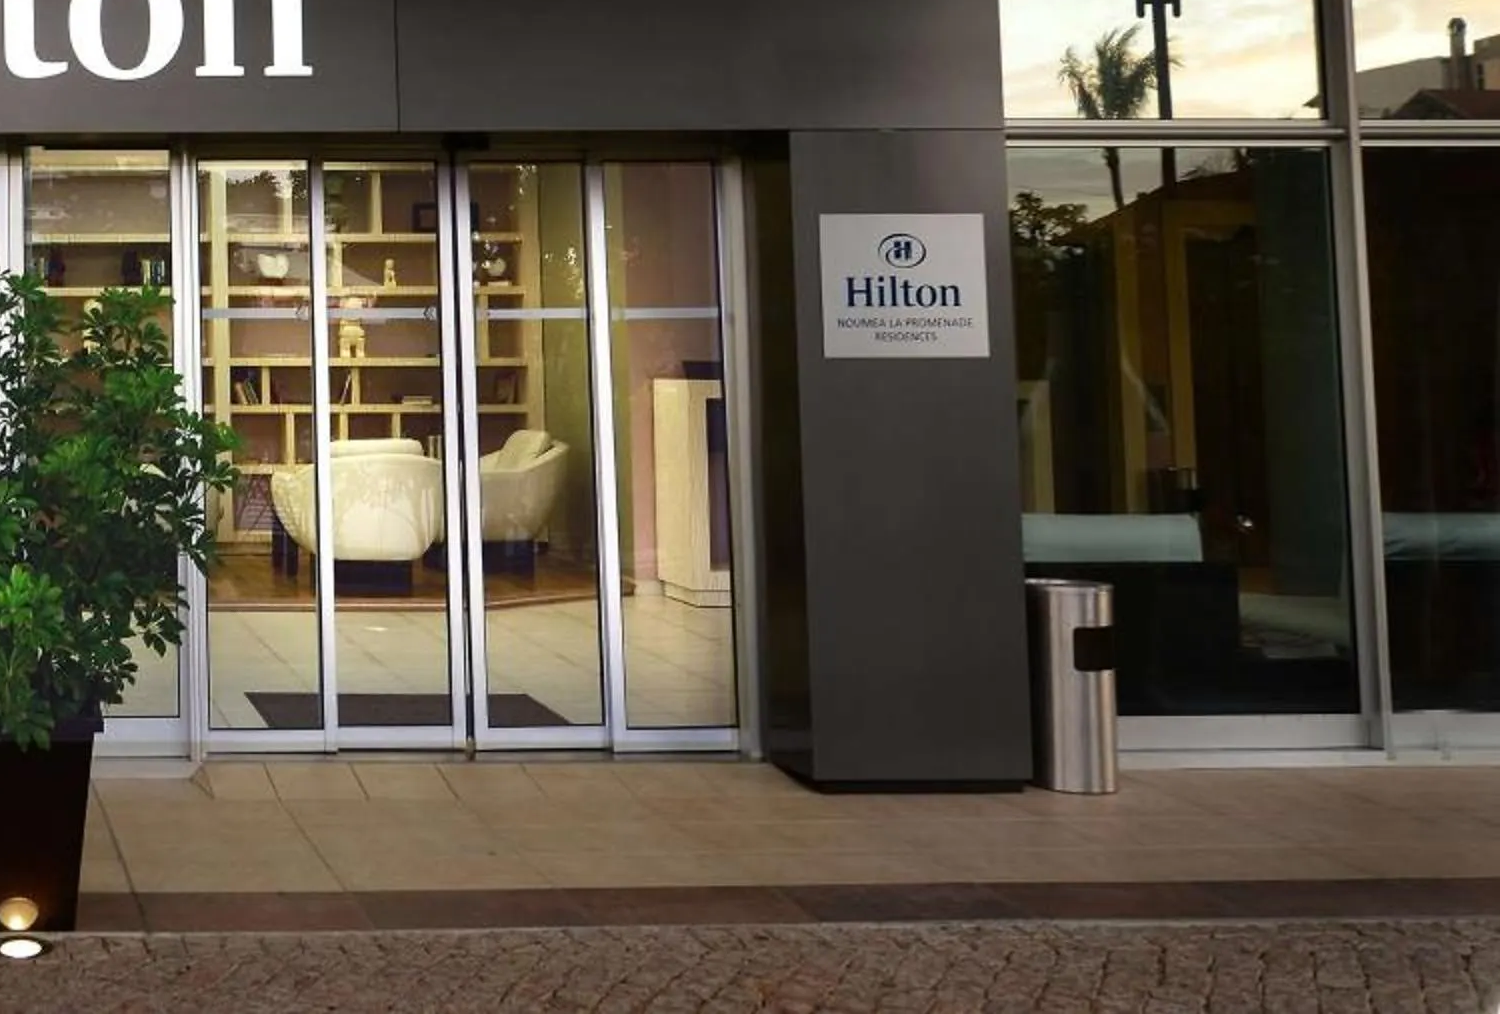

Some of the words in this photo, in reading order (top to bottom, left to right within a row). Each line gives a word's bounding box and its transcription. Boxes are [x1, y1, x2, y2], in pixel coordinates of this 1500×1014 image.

[845, 276, 962, 308] Hilton
[889, 317, 903, 329] LA
[905, 317, 973, 329] PROMENADE
[874, 331, 938, 343] RESIDENCES
